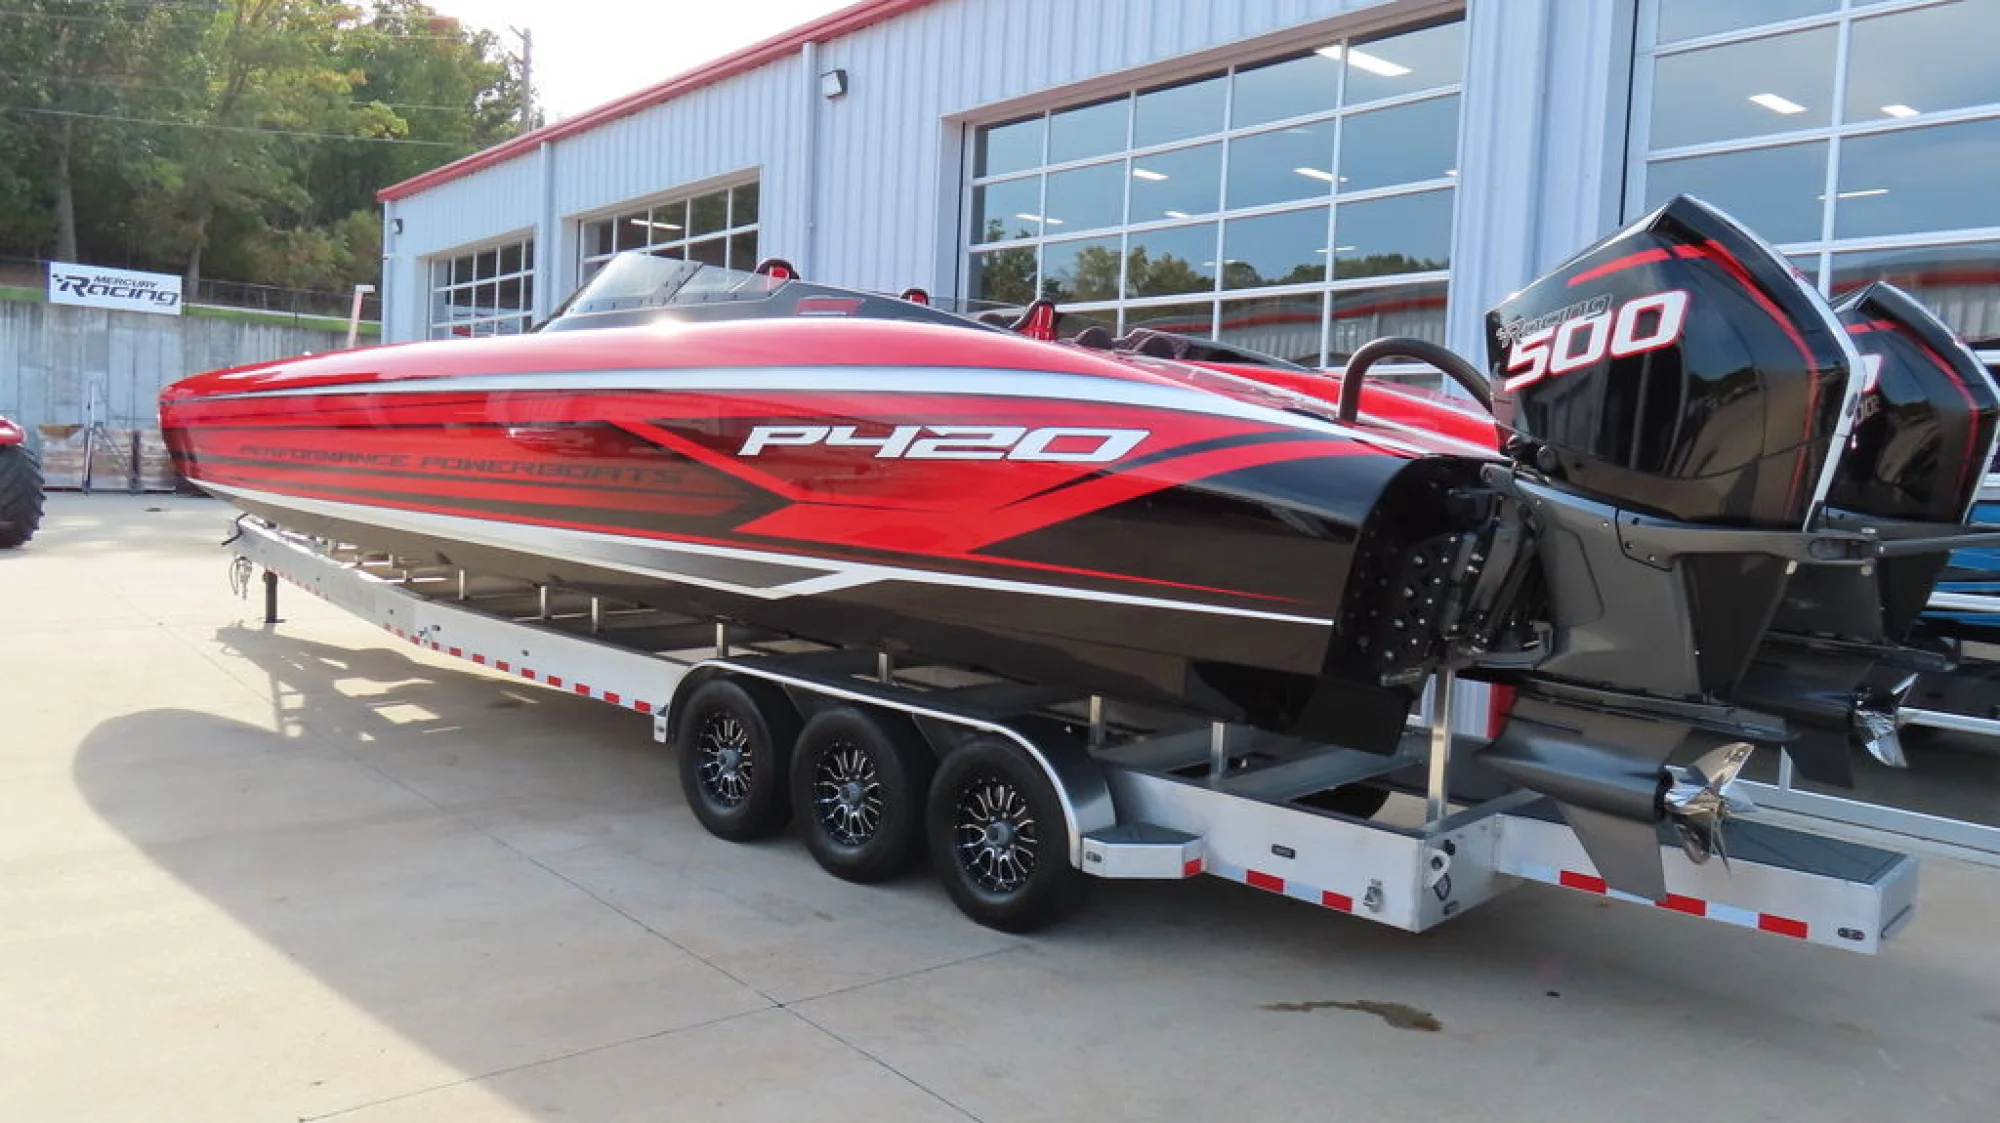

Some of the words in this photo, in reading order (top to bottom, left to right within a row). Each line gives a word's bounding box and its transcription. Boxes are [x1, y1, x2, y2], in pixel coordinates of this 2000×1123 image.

[94, 275, 158, 288] MERCURY
[1504, 289, 1690, 393] 500
[737, 425, 1151, 462] P420
[240, 445, 410, 467] PERFORMANCE
[421, 456, 683, 484] POWERBOATS
